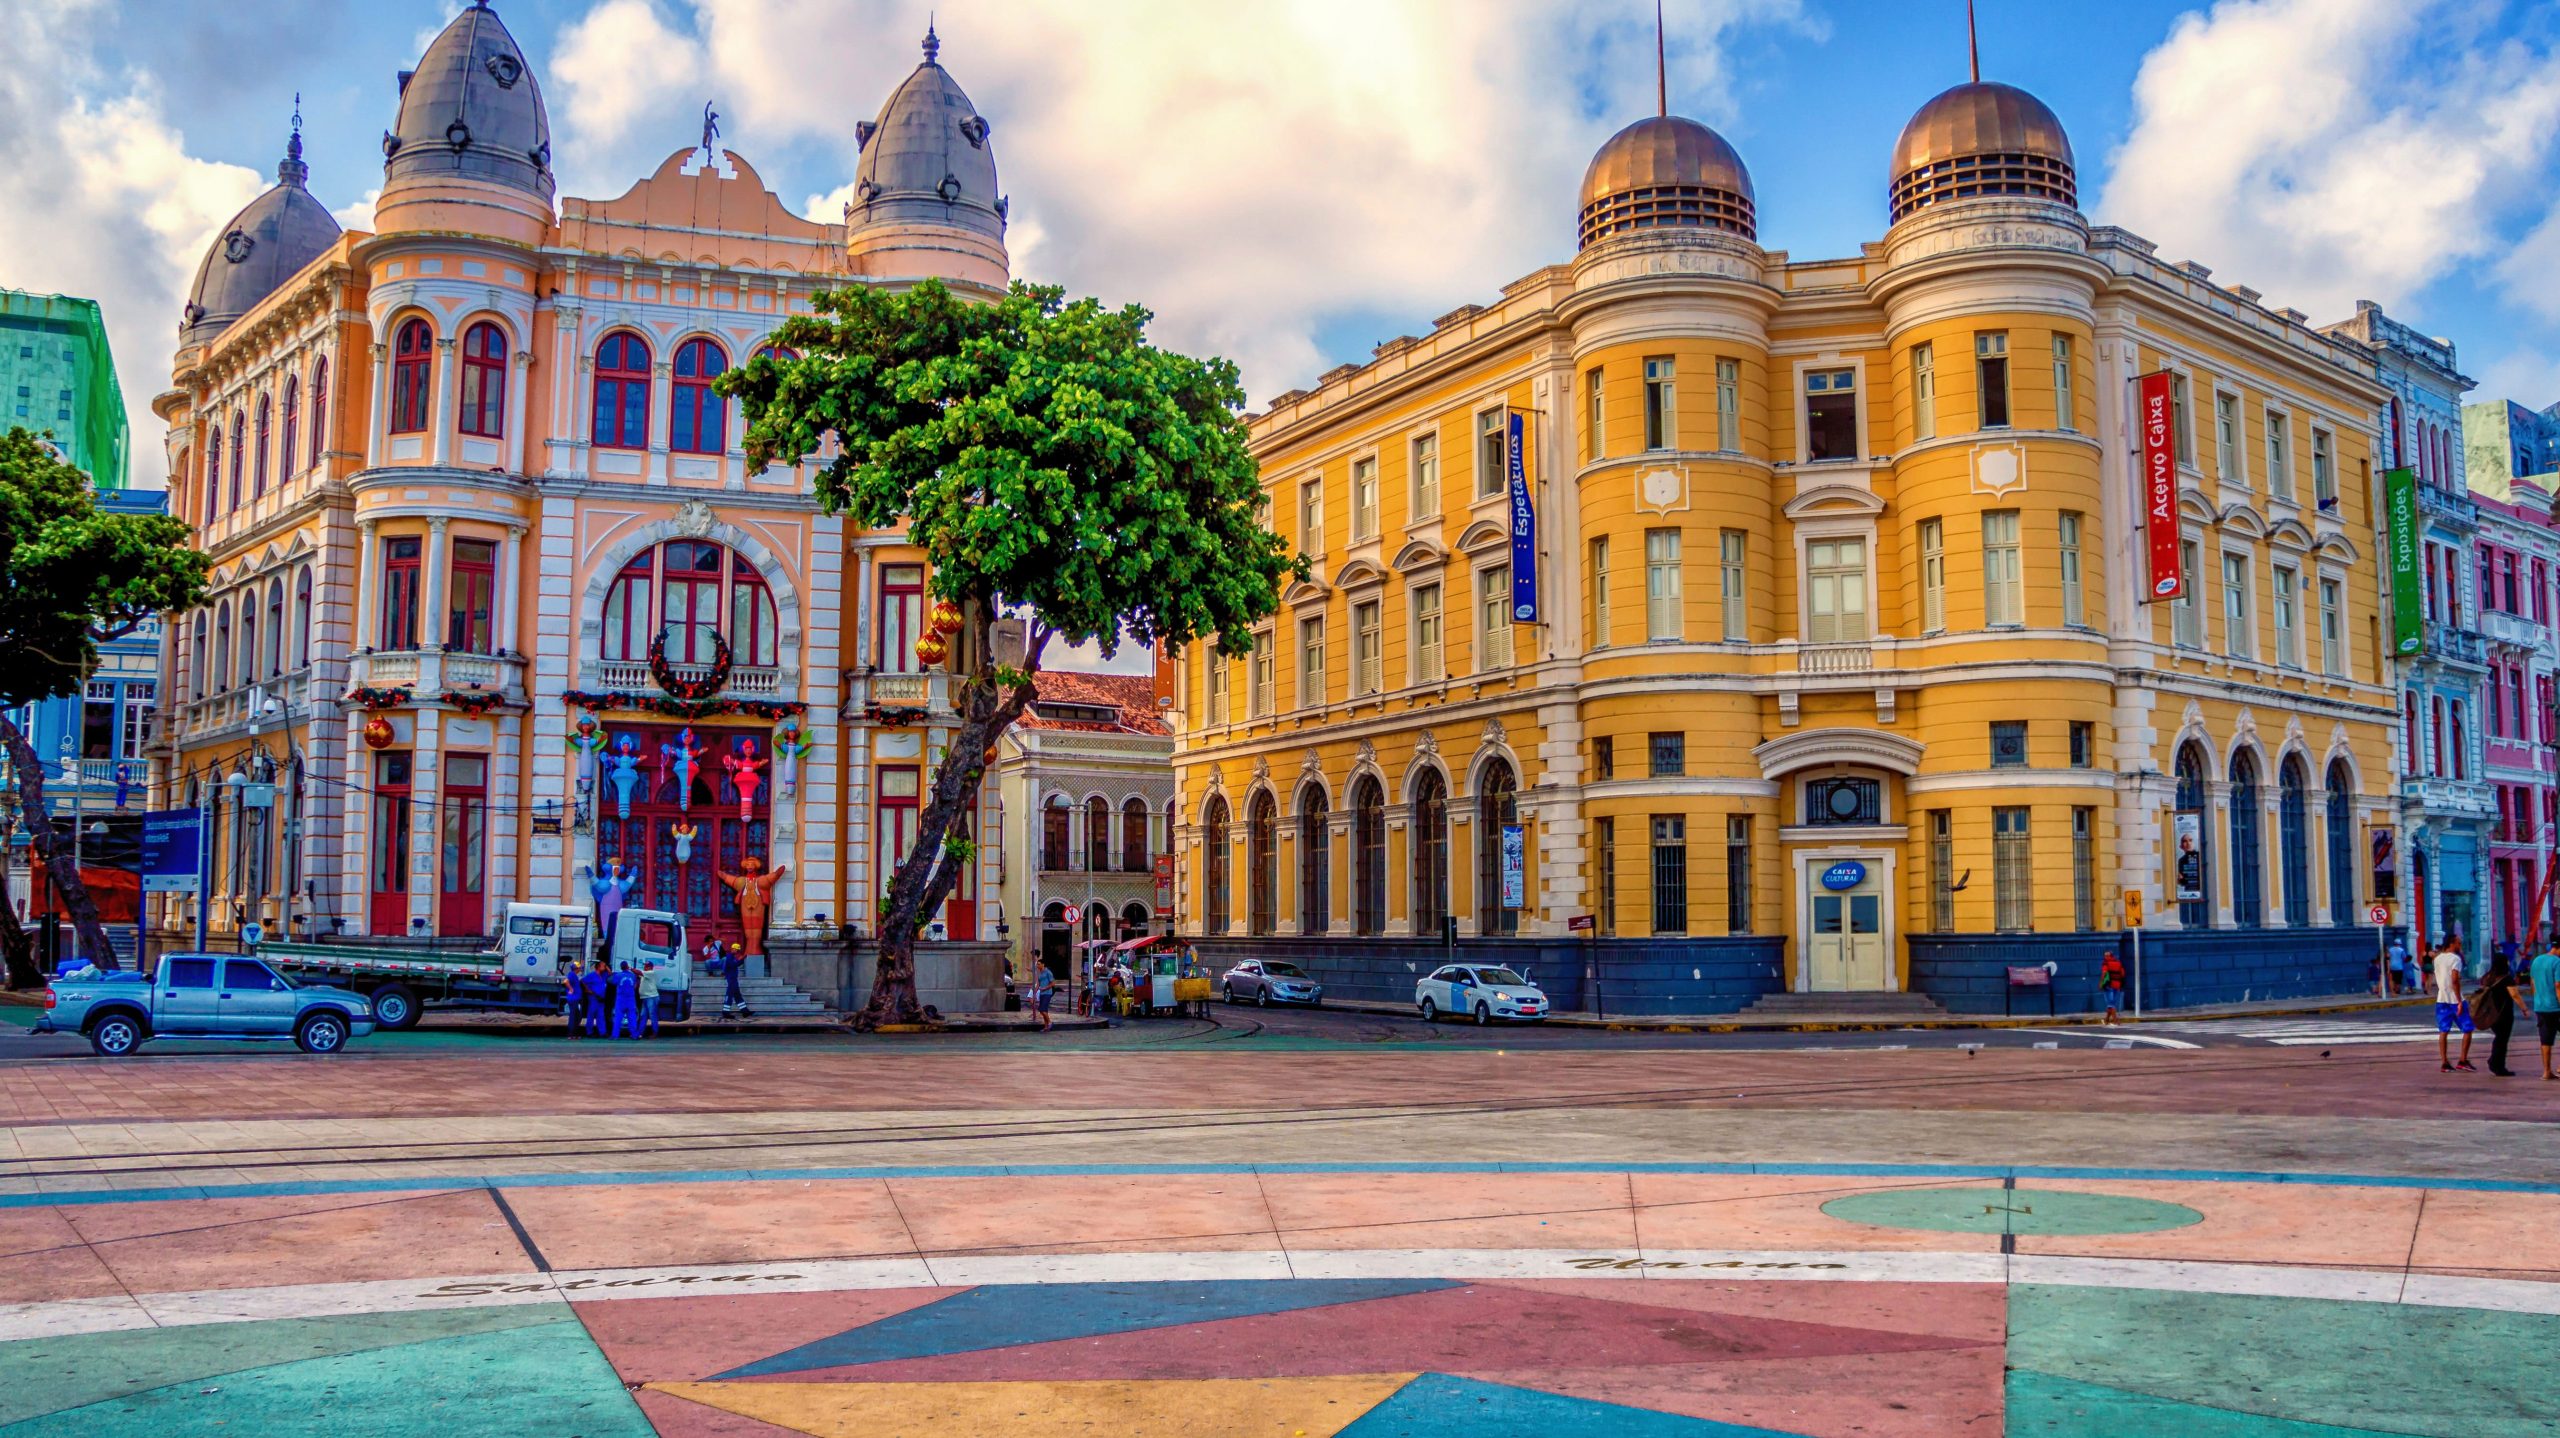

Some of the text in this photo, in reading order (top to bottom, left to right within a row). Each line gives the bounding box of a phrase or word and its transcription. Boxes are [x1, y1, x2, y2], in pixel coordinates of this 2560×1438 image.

[2148, 395, 2168, 518] Acervo Caixa
[1510, 434, 1531, 536] Espetáculos
[2394, 487, 2413, 573] Exposições
[514, 945, 549, 955] SECON
[519, 937, 547, 946] GEOP
[415, 1272, 806, 1298] Saturno
